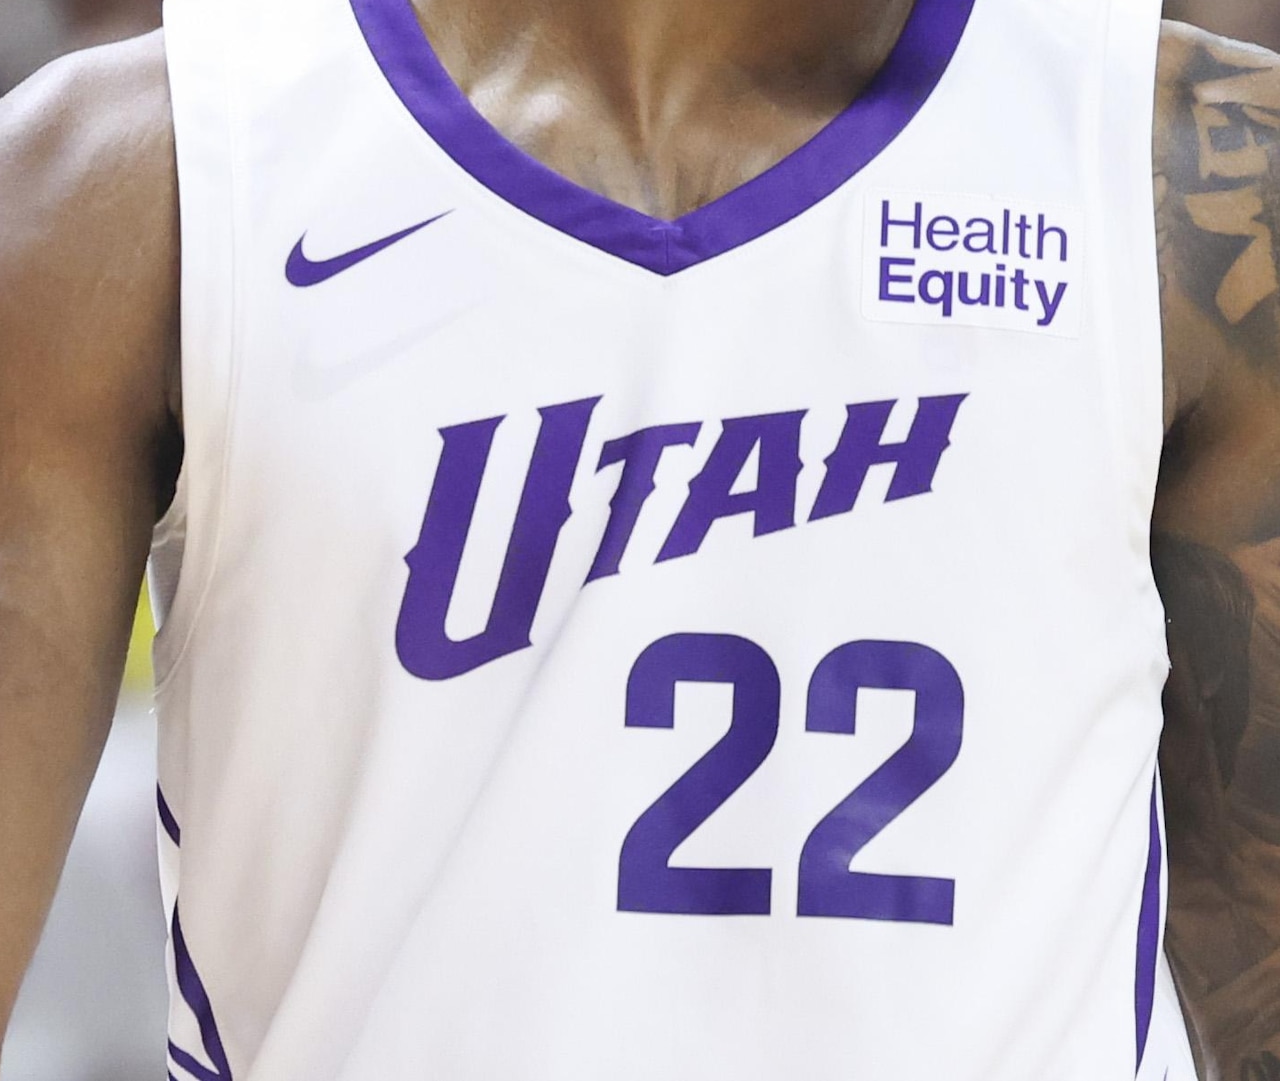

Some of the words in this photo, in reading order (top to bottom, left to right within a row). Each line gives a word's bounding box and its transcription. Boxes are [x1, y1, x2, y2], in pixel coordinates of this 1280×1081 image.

[878, 256, 1068, 327] Equity
[879, 199, 1068, 262] Health
[395, 393, 969, 682] UTAH
[616, 632, 965, 926] 22
